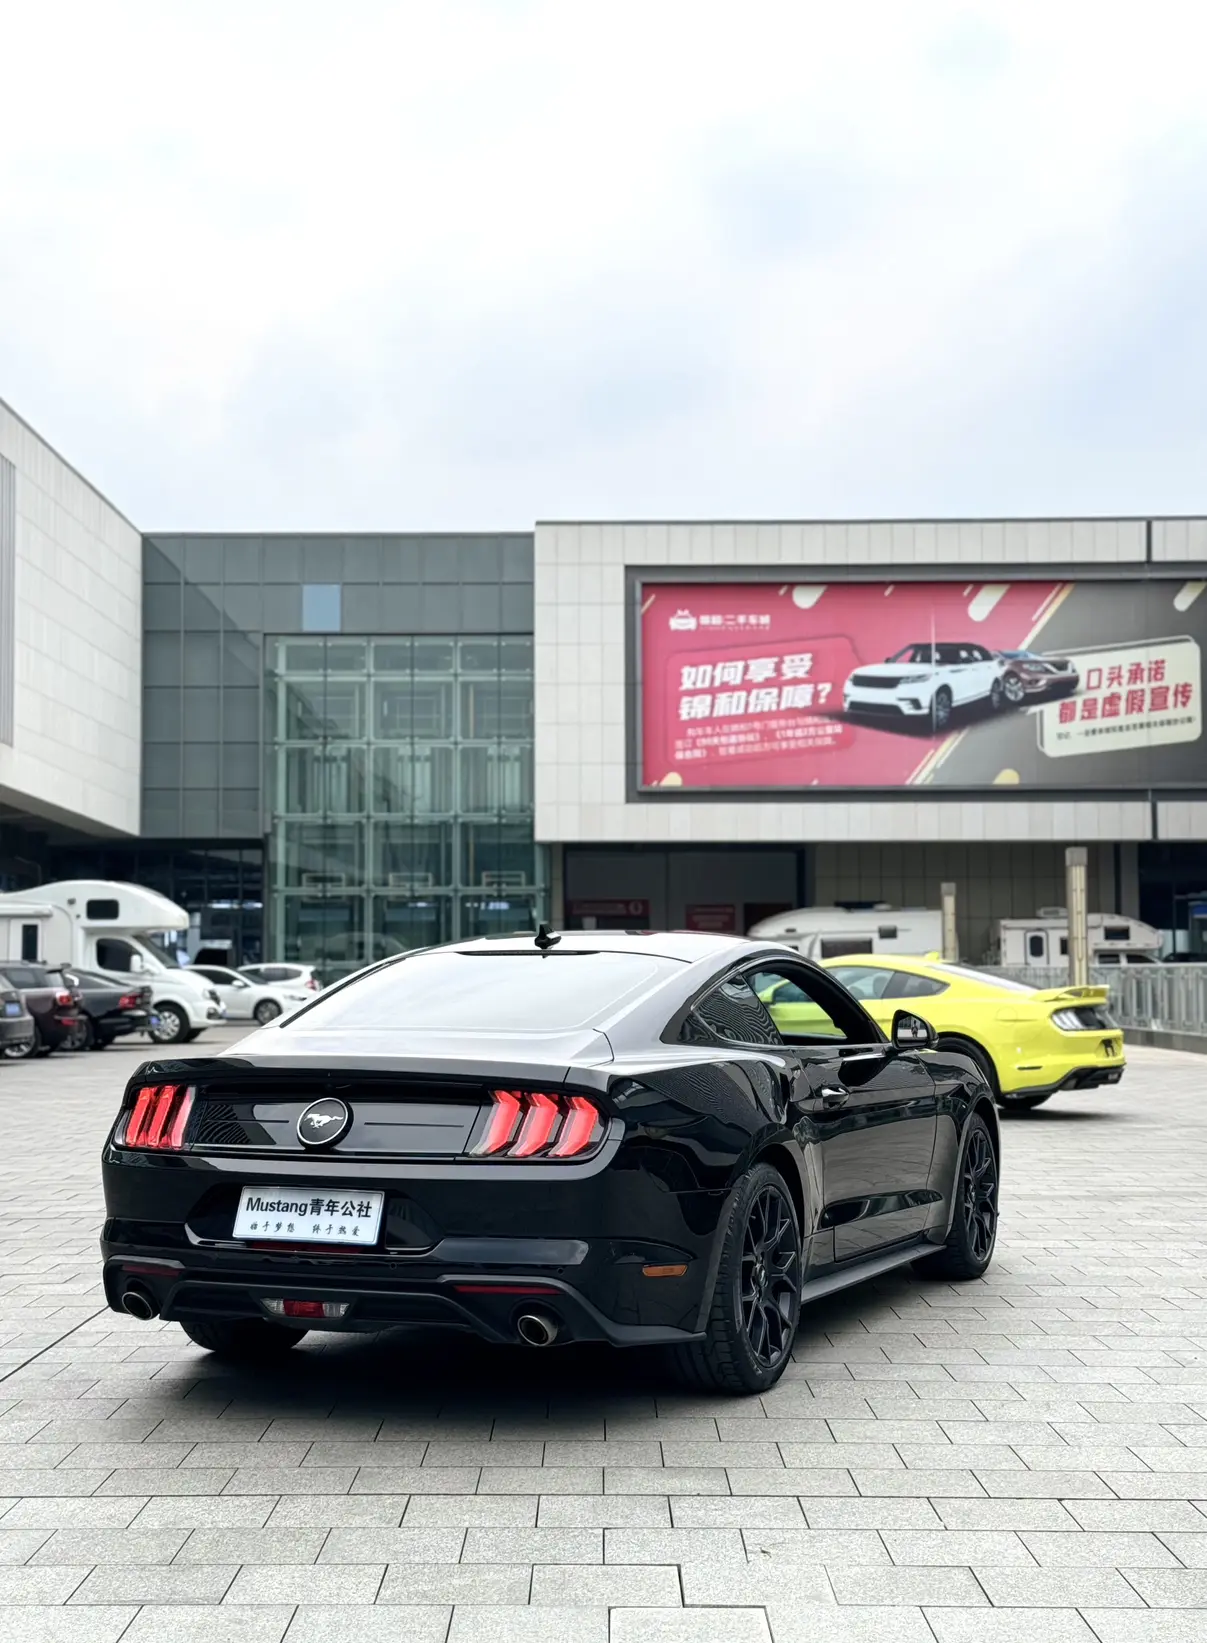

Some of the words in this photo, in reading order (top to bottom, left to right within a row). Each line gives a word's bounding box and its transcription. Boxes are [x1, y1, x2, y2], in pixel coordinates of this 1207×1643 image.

[679, 653, 813, 691] 如何享受
[1086, 659, 1166, 691] 口头承诺
[1058, 682, 1193, 724] 都是虚假宣传
[245, 1197, 373, 1218] Mustang青年公社
